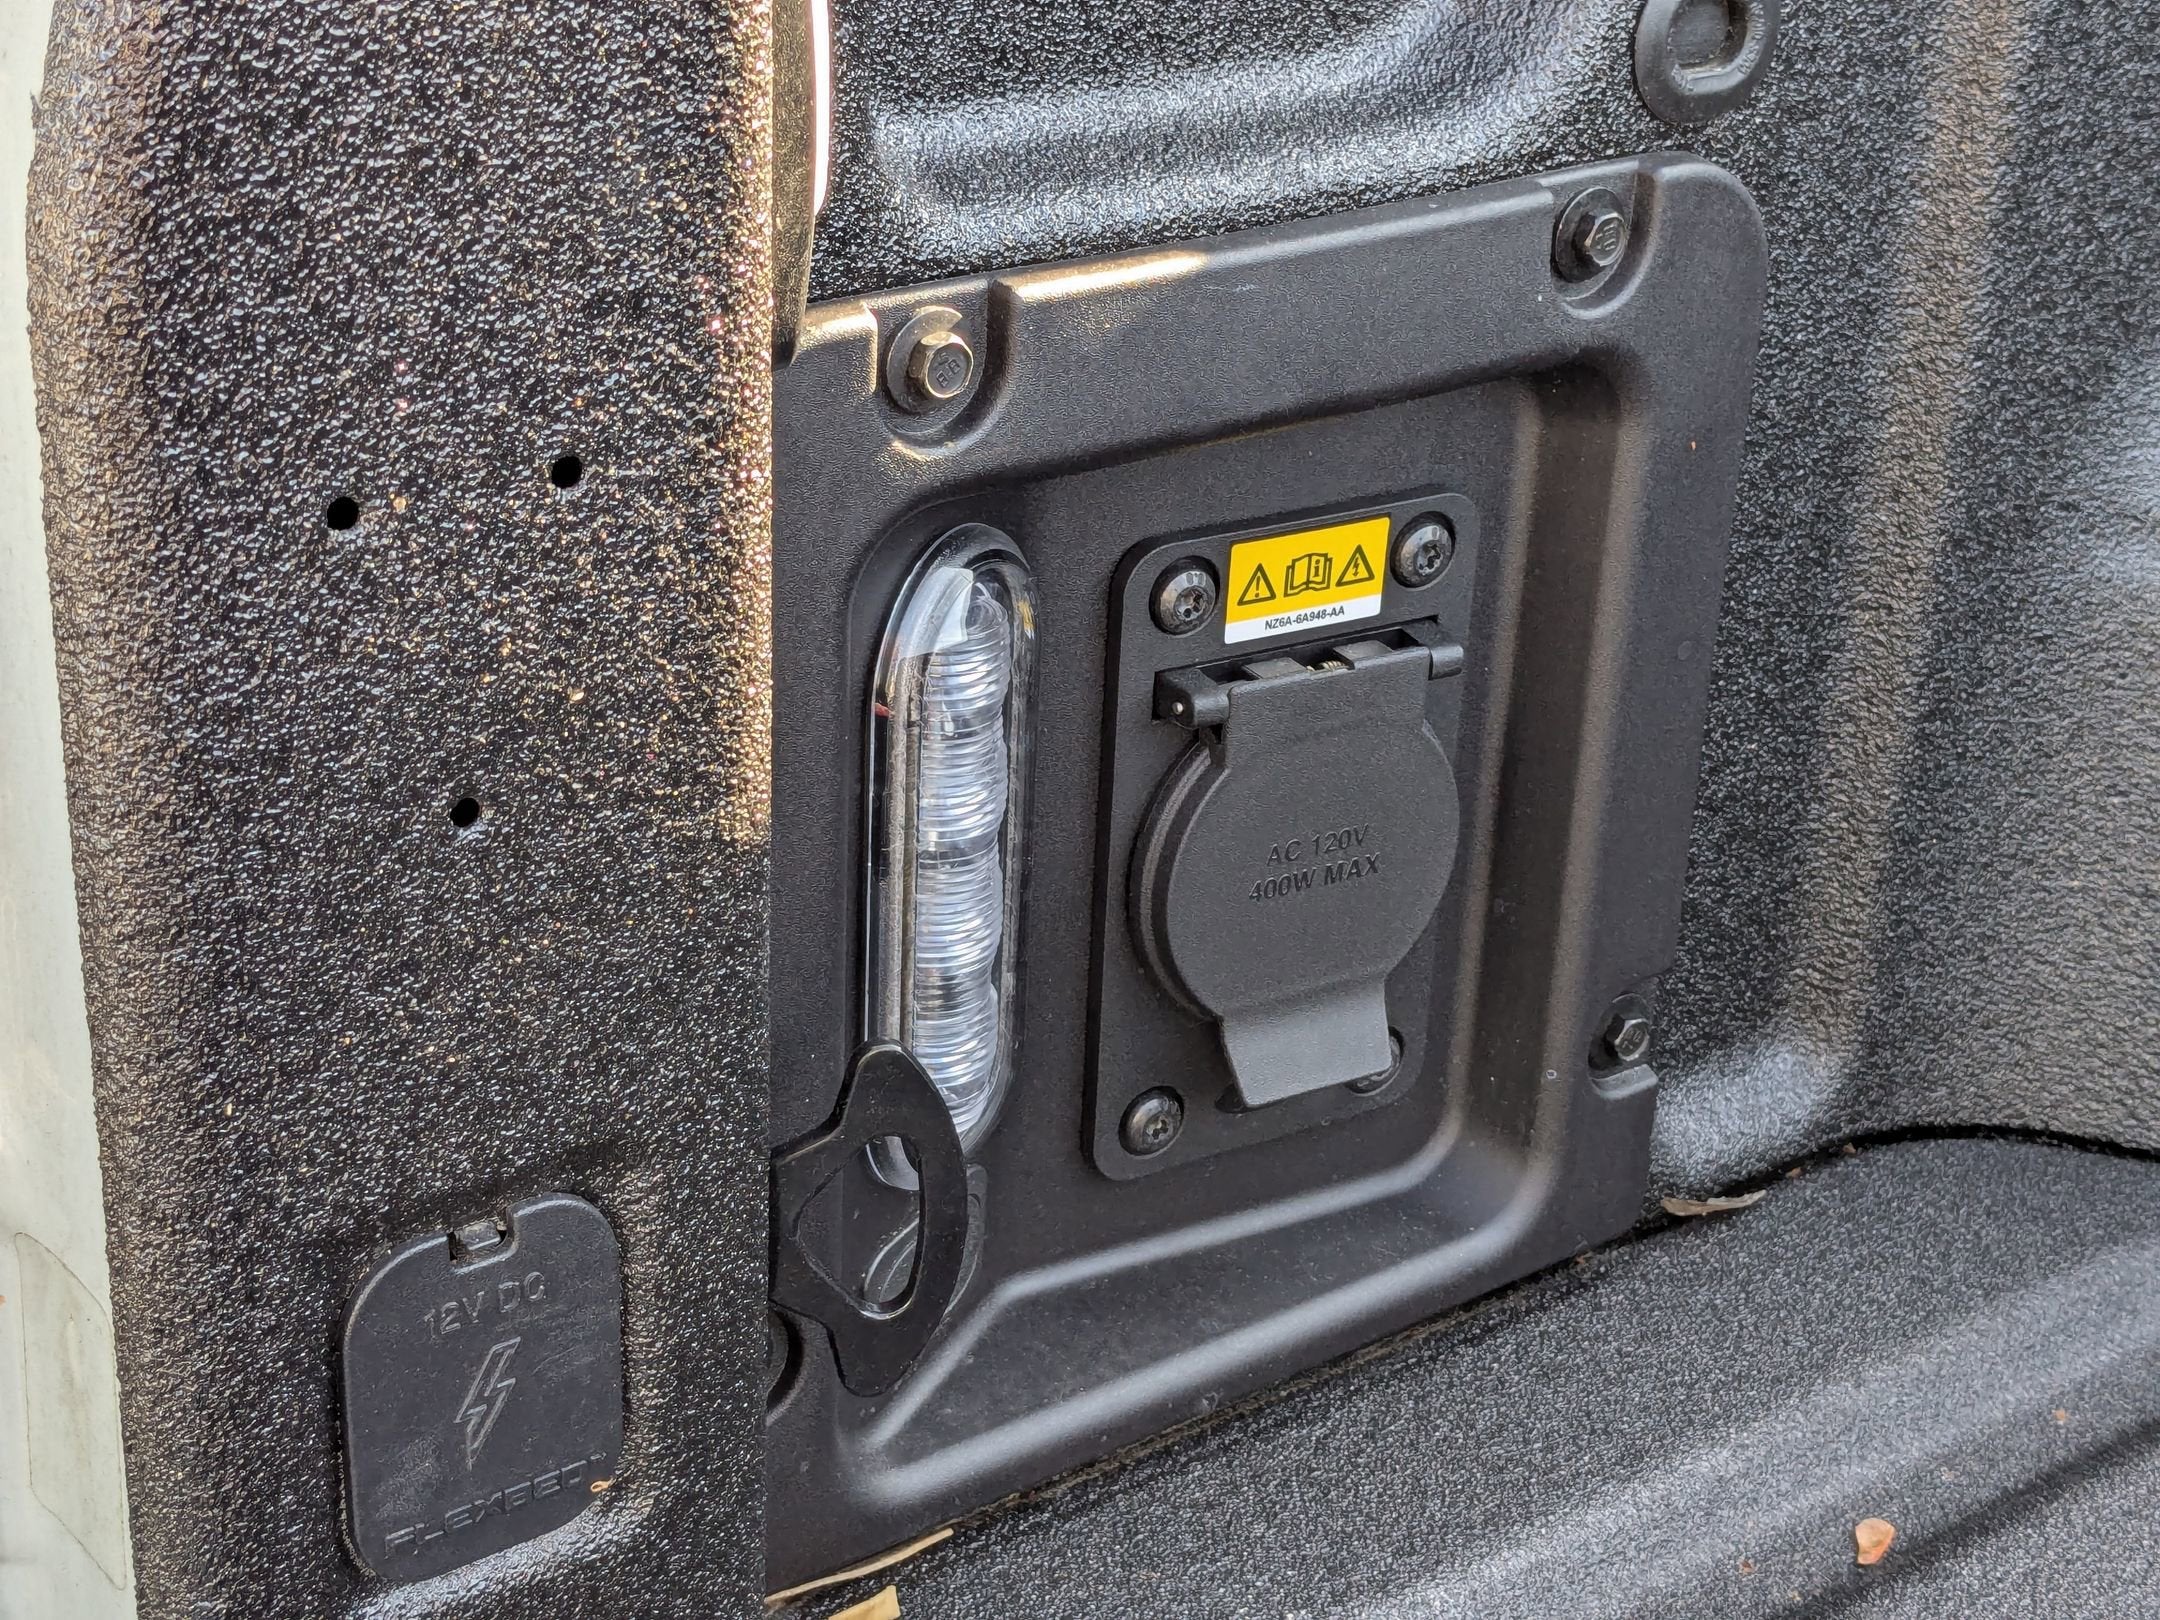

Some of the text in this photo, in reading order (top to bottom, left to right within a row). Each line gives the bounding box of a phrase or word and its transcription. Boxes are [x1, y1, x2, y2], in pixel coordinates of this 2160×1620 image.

[1264, 605, 1345, 631] NZ6A-6A948-AA
[1266, 822, 1369, 867] AC 120V
[1249, 851, 1381, 902] 400W MAX
[423, 1271, 546, 1343] 12V DC
